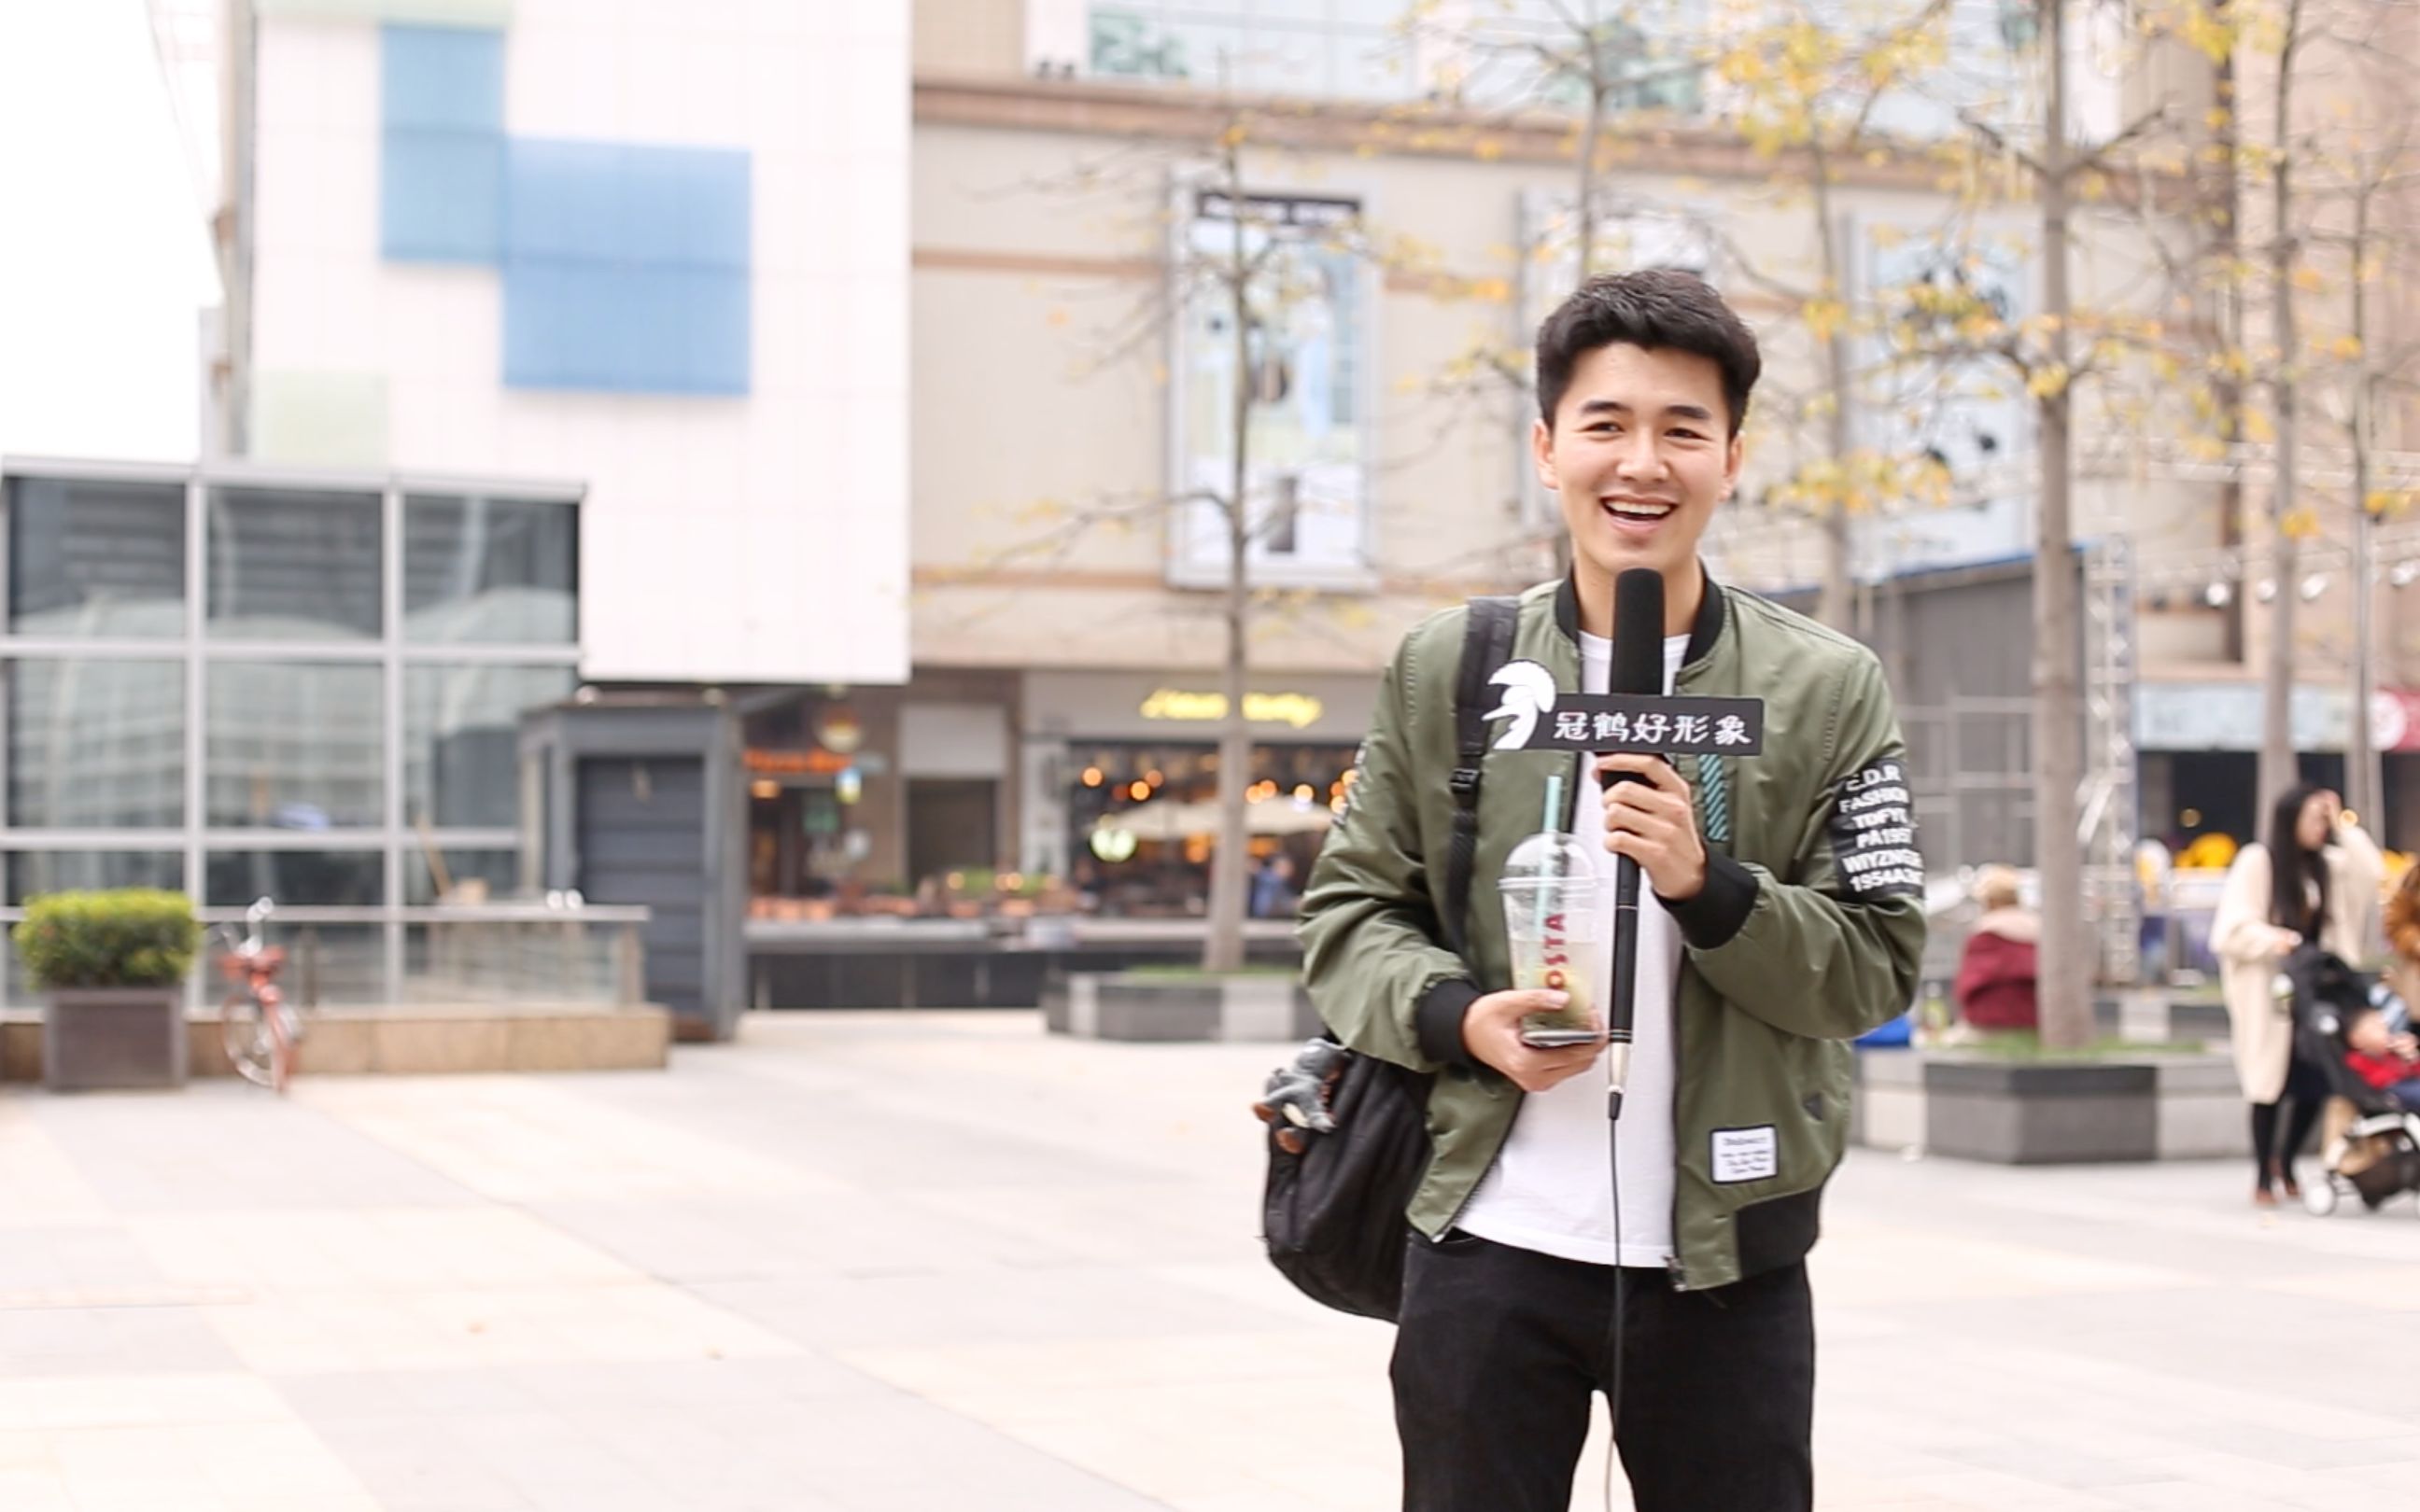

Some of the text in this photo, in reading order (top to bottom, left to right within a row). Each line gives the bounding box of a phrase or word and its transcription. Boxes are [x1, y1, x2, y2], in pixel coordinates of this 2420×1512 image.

[1554, 711, 1752, 745] 冠鹤好形象
[1544, 914, 1567, 990] OSTA
